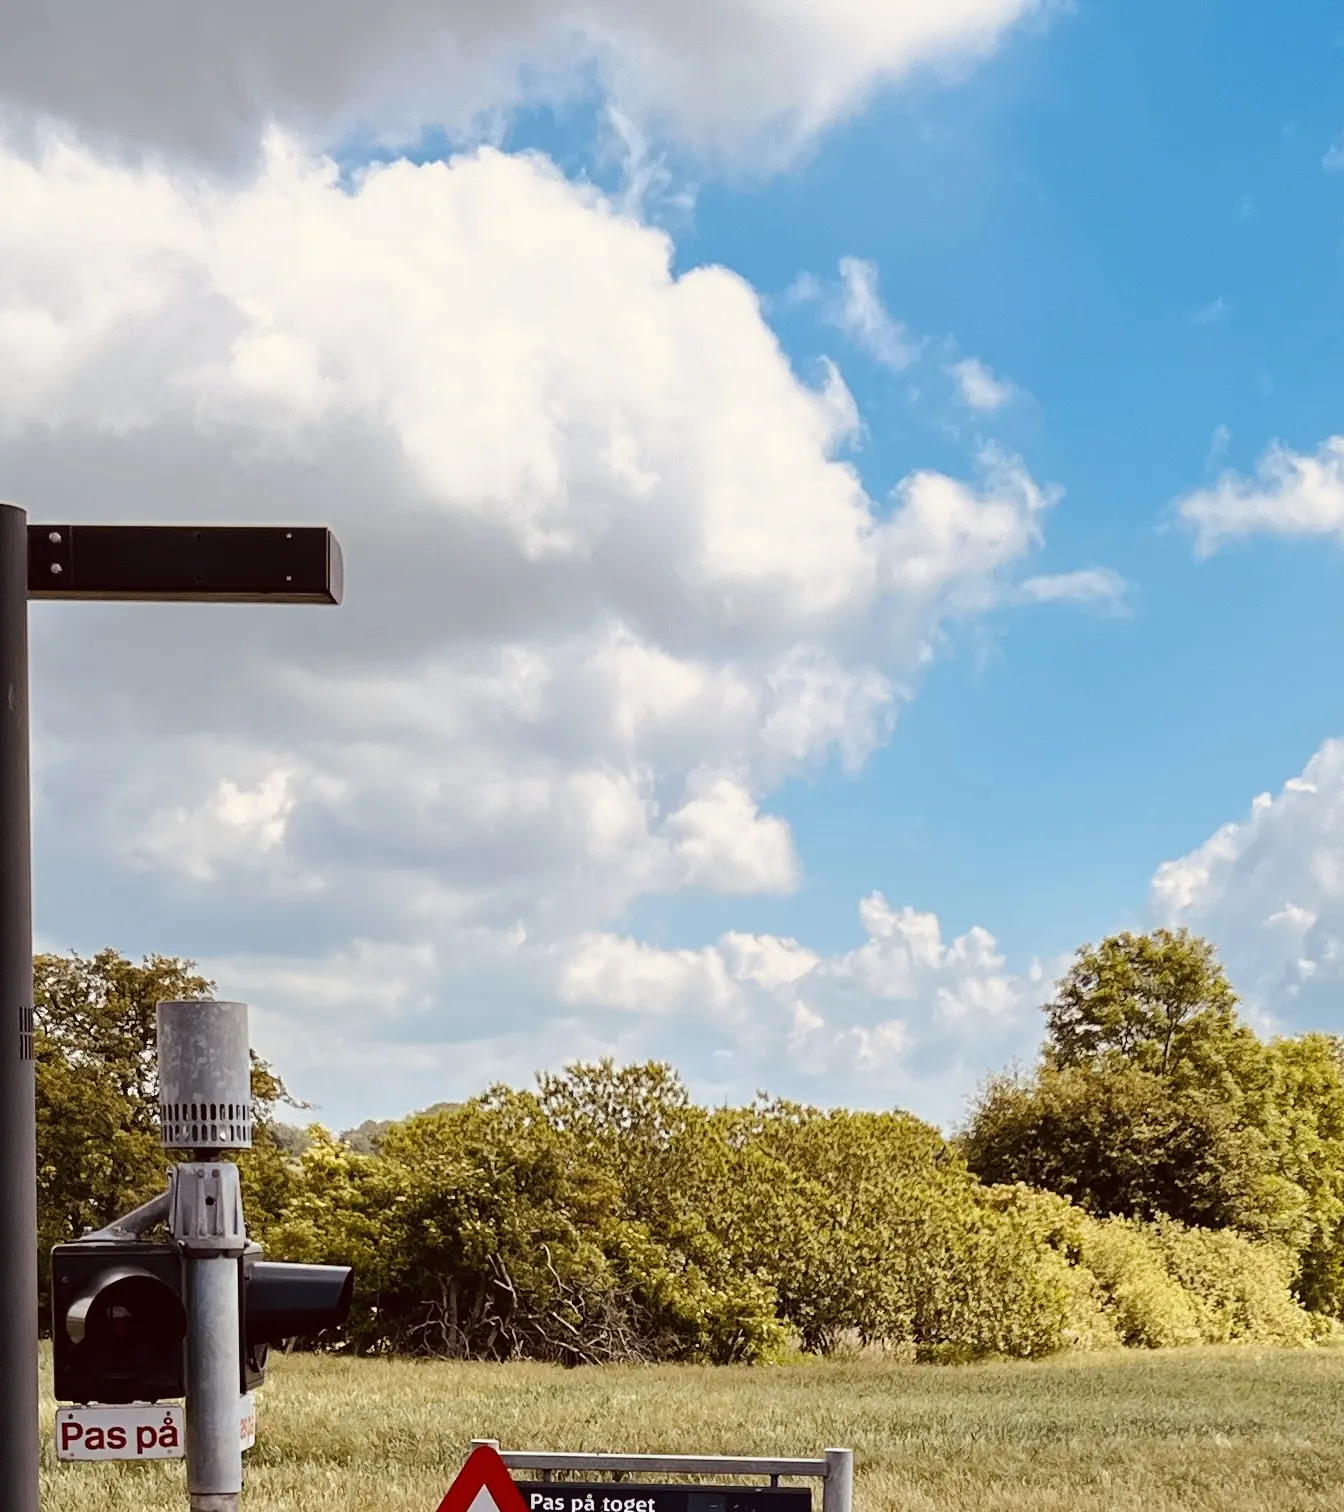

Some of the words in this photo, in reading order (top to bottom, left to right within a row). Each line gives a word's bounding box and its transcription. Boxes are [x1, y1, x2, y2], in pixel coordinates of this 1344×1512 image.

[61, 1422, 127, 1450] Pas
[136, 1416, 179, 1454] på
[530, 1493, 565, 1511] Pas
